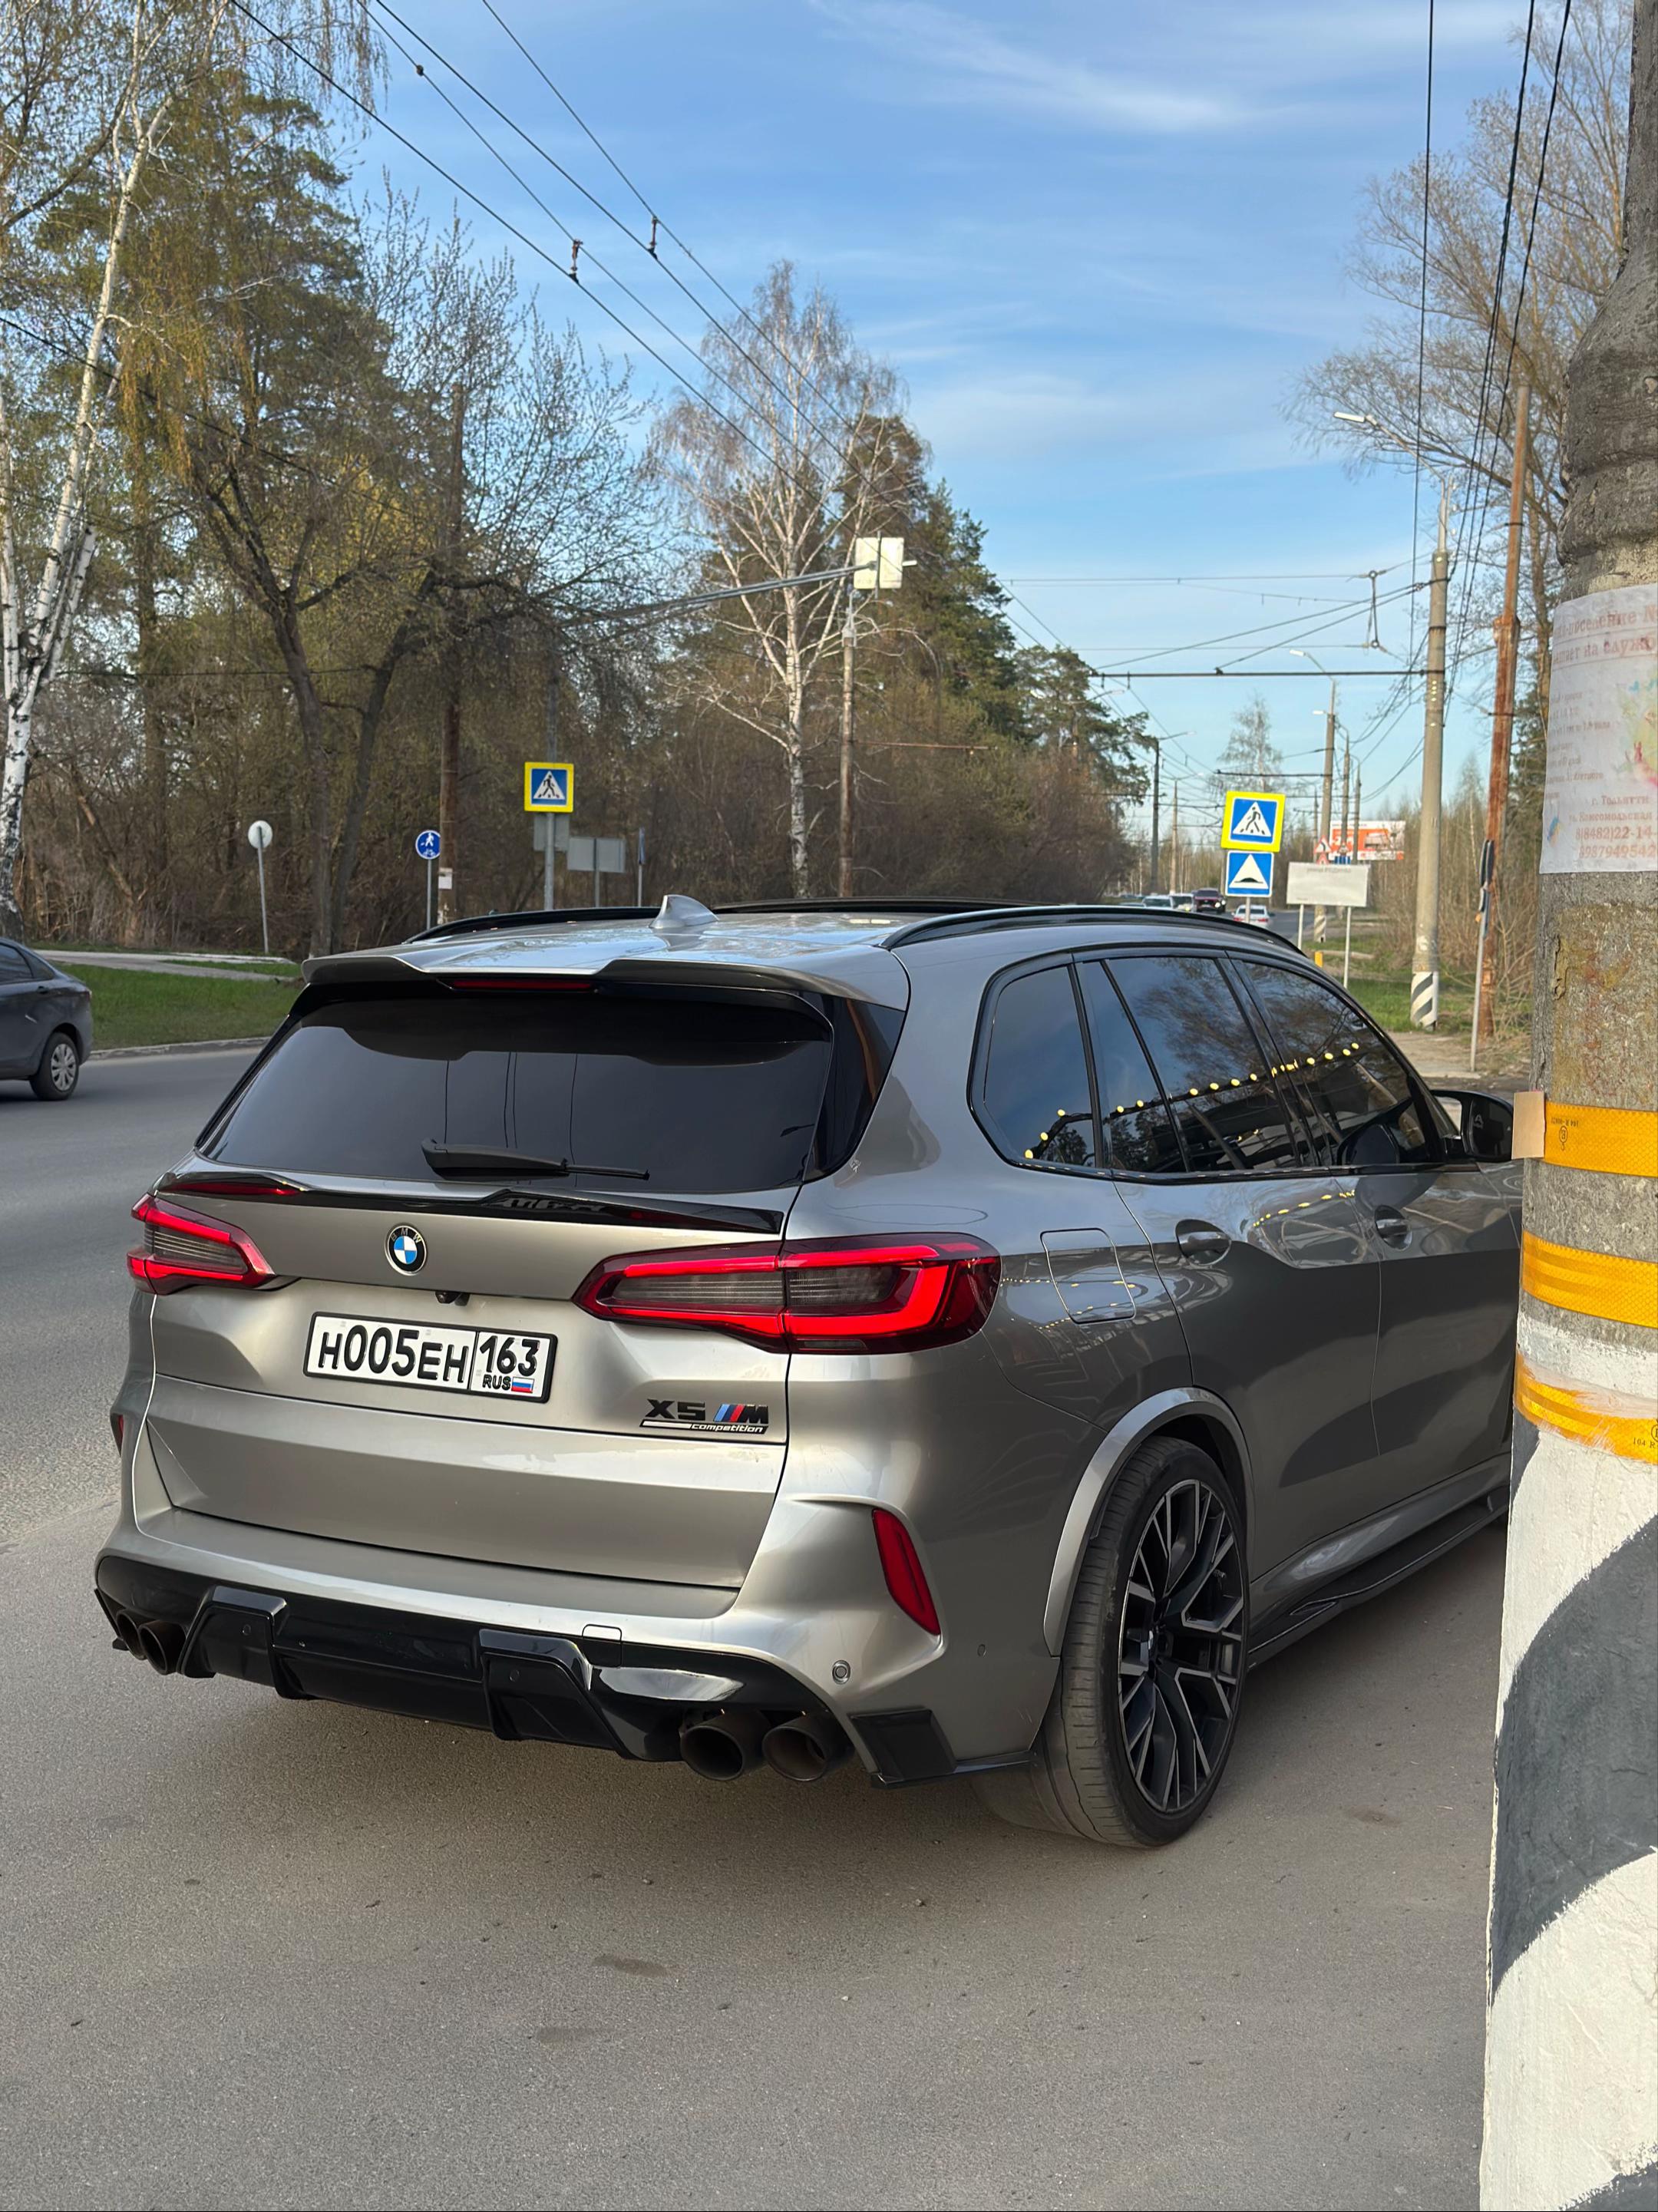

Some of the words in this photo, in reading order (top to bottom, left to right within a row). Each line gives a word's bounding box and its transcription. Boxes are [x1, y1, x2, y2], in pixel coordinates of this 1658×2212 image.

[1584, 643, 1597, 658] на
[1601, 795, 1649, 806] Тольятти
[391, 1227, 421, 1243] BMW
[479, 1335, 540, 1377] 163
[482, 1375, 511, 1391] RUS
[645, 1398, 706, 1421] X5
[690, 1423, 764, 1434] competition
